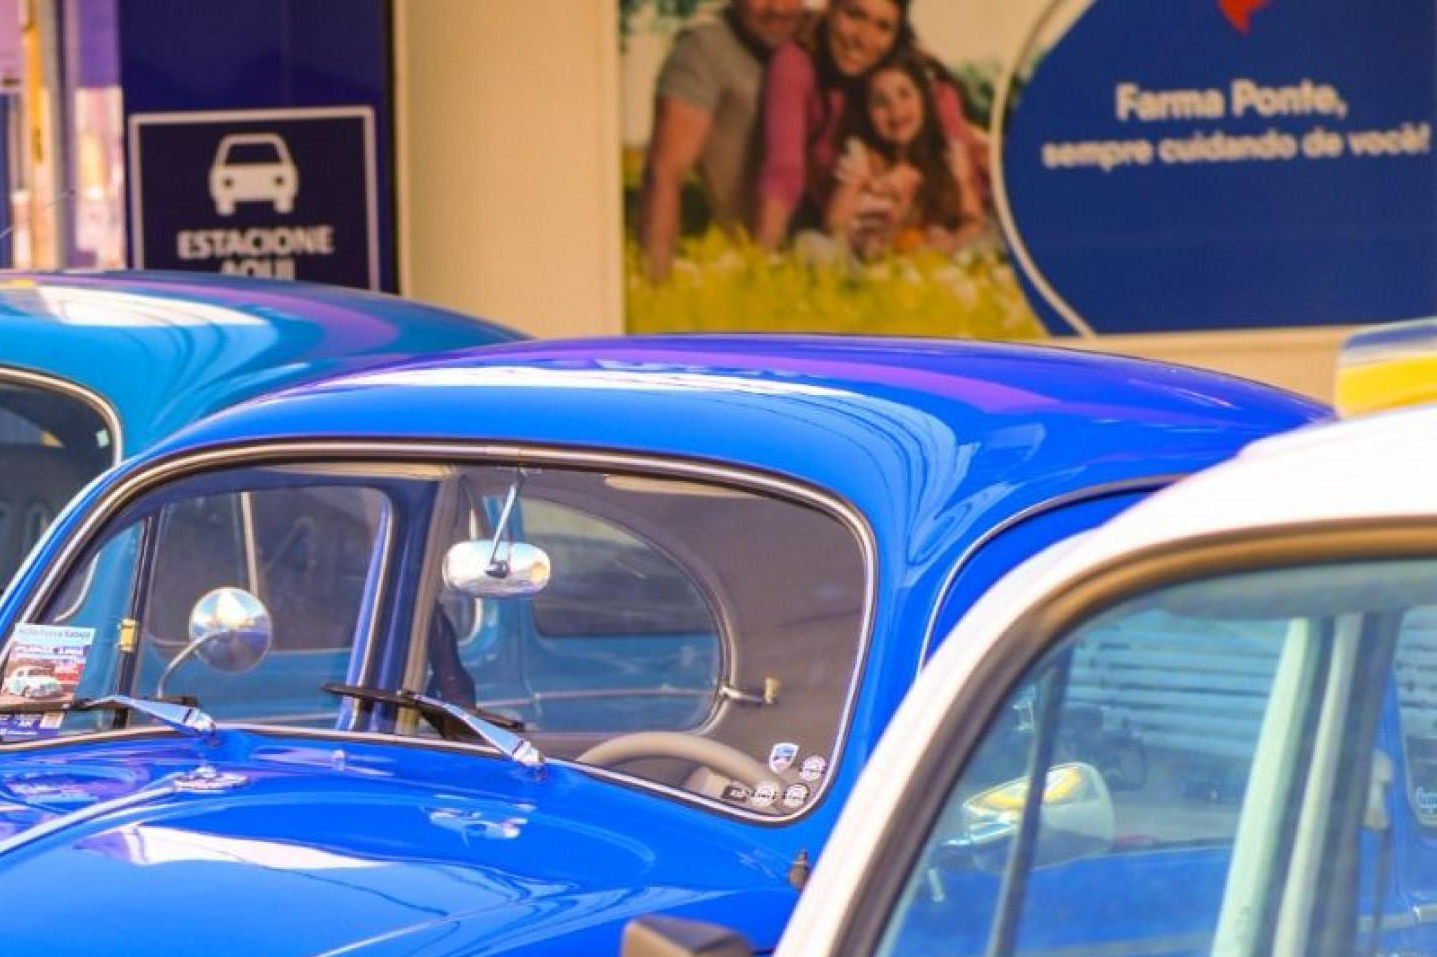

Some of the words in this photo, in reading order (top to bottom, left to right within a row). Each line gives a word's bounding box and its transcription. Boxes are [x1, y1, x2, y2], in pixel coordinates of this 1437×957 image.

[1116, 82, 1225, 121] Farma
[1230, 78, 1347, 121] Ponte,
[1042, 139, 1153, 172] sempre
[1158, 129, 1298, 163] cuidando
[1301, 127, 1344, 158] de
[176, 225, 335, 260] ESTACIONE
